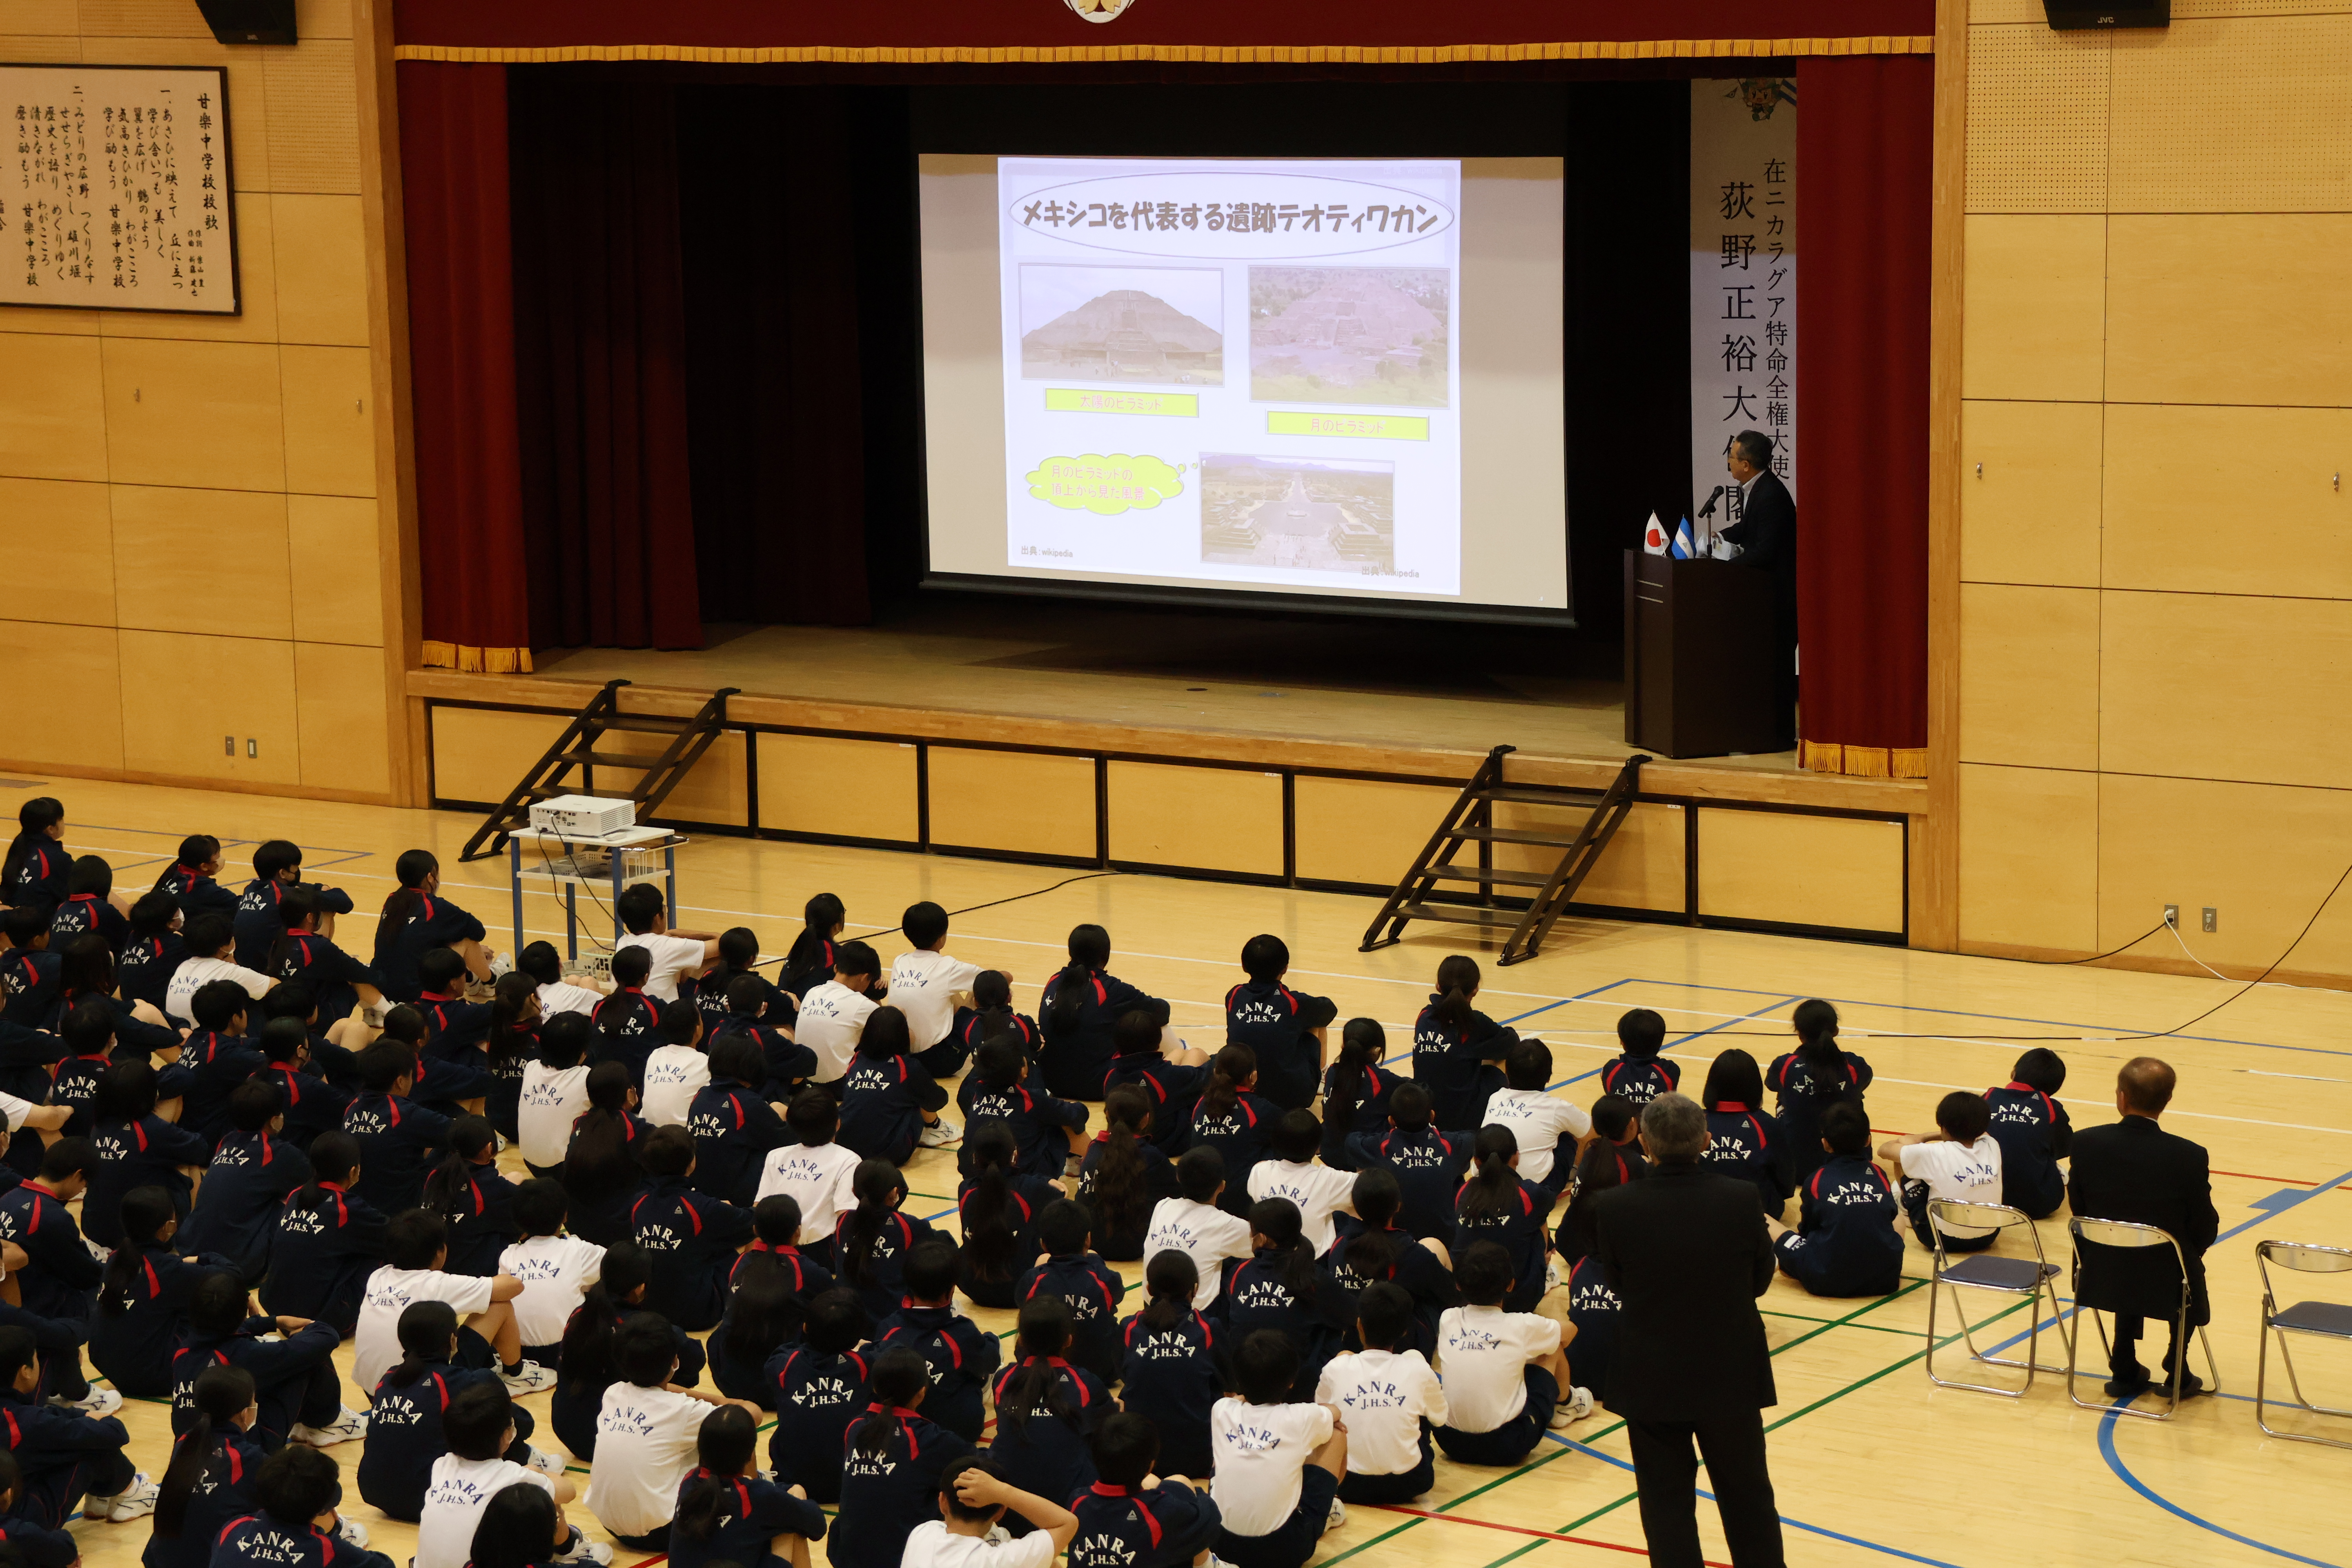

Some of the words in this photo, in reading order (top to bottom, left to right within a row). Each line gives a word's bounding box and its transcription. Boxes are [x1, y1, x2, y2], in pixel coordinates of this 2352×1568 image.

[197, 93, 218, 230] 甘楽中学校校歌
[1023, 199, 1438, 234] メキシコを代表する遺跡テオティワカン
[154, 209, 165, 258] 美しく
[22, 203, 39, 286] 甘楽中学校
[81, 212, 95, 285] つくりなす
[109, 204, 125, 288] 甘楽中学校
[171, 233, 183, 289] 丘に立つ
[1764, 158, 1789, 480] 在ニカラグア特命全権大使
[1080, 394, 1163, 412] 太陽のピラミッド
[1310, 417, 1386, 434] 月のピラミッド
[1051, 465, 1133, 482] 月のピラミッドの
[1051, 483, 1145, 502] 頂上から見た風景
[703, 1002, 722, 1012] J.H.S.
[1236, 1002, 1281, 1022] KANRA
[1246, 1014, 1269, 1023] J.H.S.
[1419, 1044, 1439, 1053] J.H.S.
[653, 1075, 673, 1083] J.H.S.
[847, 1069, 890, 1091] KANRA
[855, 1082, 877, 1090] J.H.S.
[67, 1089, 90, 1098] J.H.S.
[523, 1083, 563, 1106] KANRA
[531, 1097, 551, 1106] J.H.S.
[972, 1094, 1014, 1117] KANRA
[978, 1105, 999, 1116] J.H.S.
[1495, 1109, 1518, 1118] J.H.S.
[2000, 1114, 2027, 1123] J.H.S.
[351, 1125, 372, 1133] J.H.S.
[694, 1128, 713, 1137] J.H.S.
[1203, 1125, 1227, 1135] J.H.S.
[1392, 1146, 1443, 1165] KANRA
[1713, 1152, 1739, 1161] J.H.S.
[1406, 1158, 1433, 1168] J.H.S.
[777, 1159, 824, 1181] KANRA
[788, 1171, 808, 1181] J.H.S.
[1828, 1182, 1883, 1204] KANRA
[1845, 1195, 1872, 1205] J.H.S.
[287, 1222, 308, 1232] J.H.S.
[1151, 1223, 1198, 1249] KANRA
[1158, 1237, 1182, 1248] J.H.S.
[1238, 1281, 1294, 1307] KANRA
[1250, 1296, 1279, 1307] J.H.S.
[1582, 1300, 1610, 1310] J.H.S.
[1136, 1332, 1196, 1357] KANRA
[1459, 1340, 1485, 1351] J.H.S.
[1152, 1348, 1182, 1359] J.H.S.
[792, 1377, 854, 1405] KANRA
[1343, 1381, 1406, 1406] KANRA
[810, 1394, 841, 1407] J.H.S.
[1361, 1398, 1391, 1410] J.H.S.
[371, 1396, 423, 1425] KANRA
[379, 1412, 405, 1425] J.H.S.
[610, 1422, 635, 1434] J.H.S.
[852, 1463, 879, 1475] J.H.S.
[437, 1493, 465, 1504] J.H.S.
[237, 1531, 305, 1564] KANRA
[251, 1546, 285, 1562] J.H.S.
[1074, 1534, 1136, 1565] KANRA
[1089, 1553, 1119, 1566] J.H.S.
